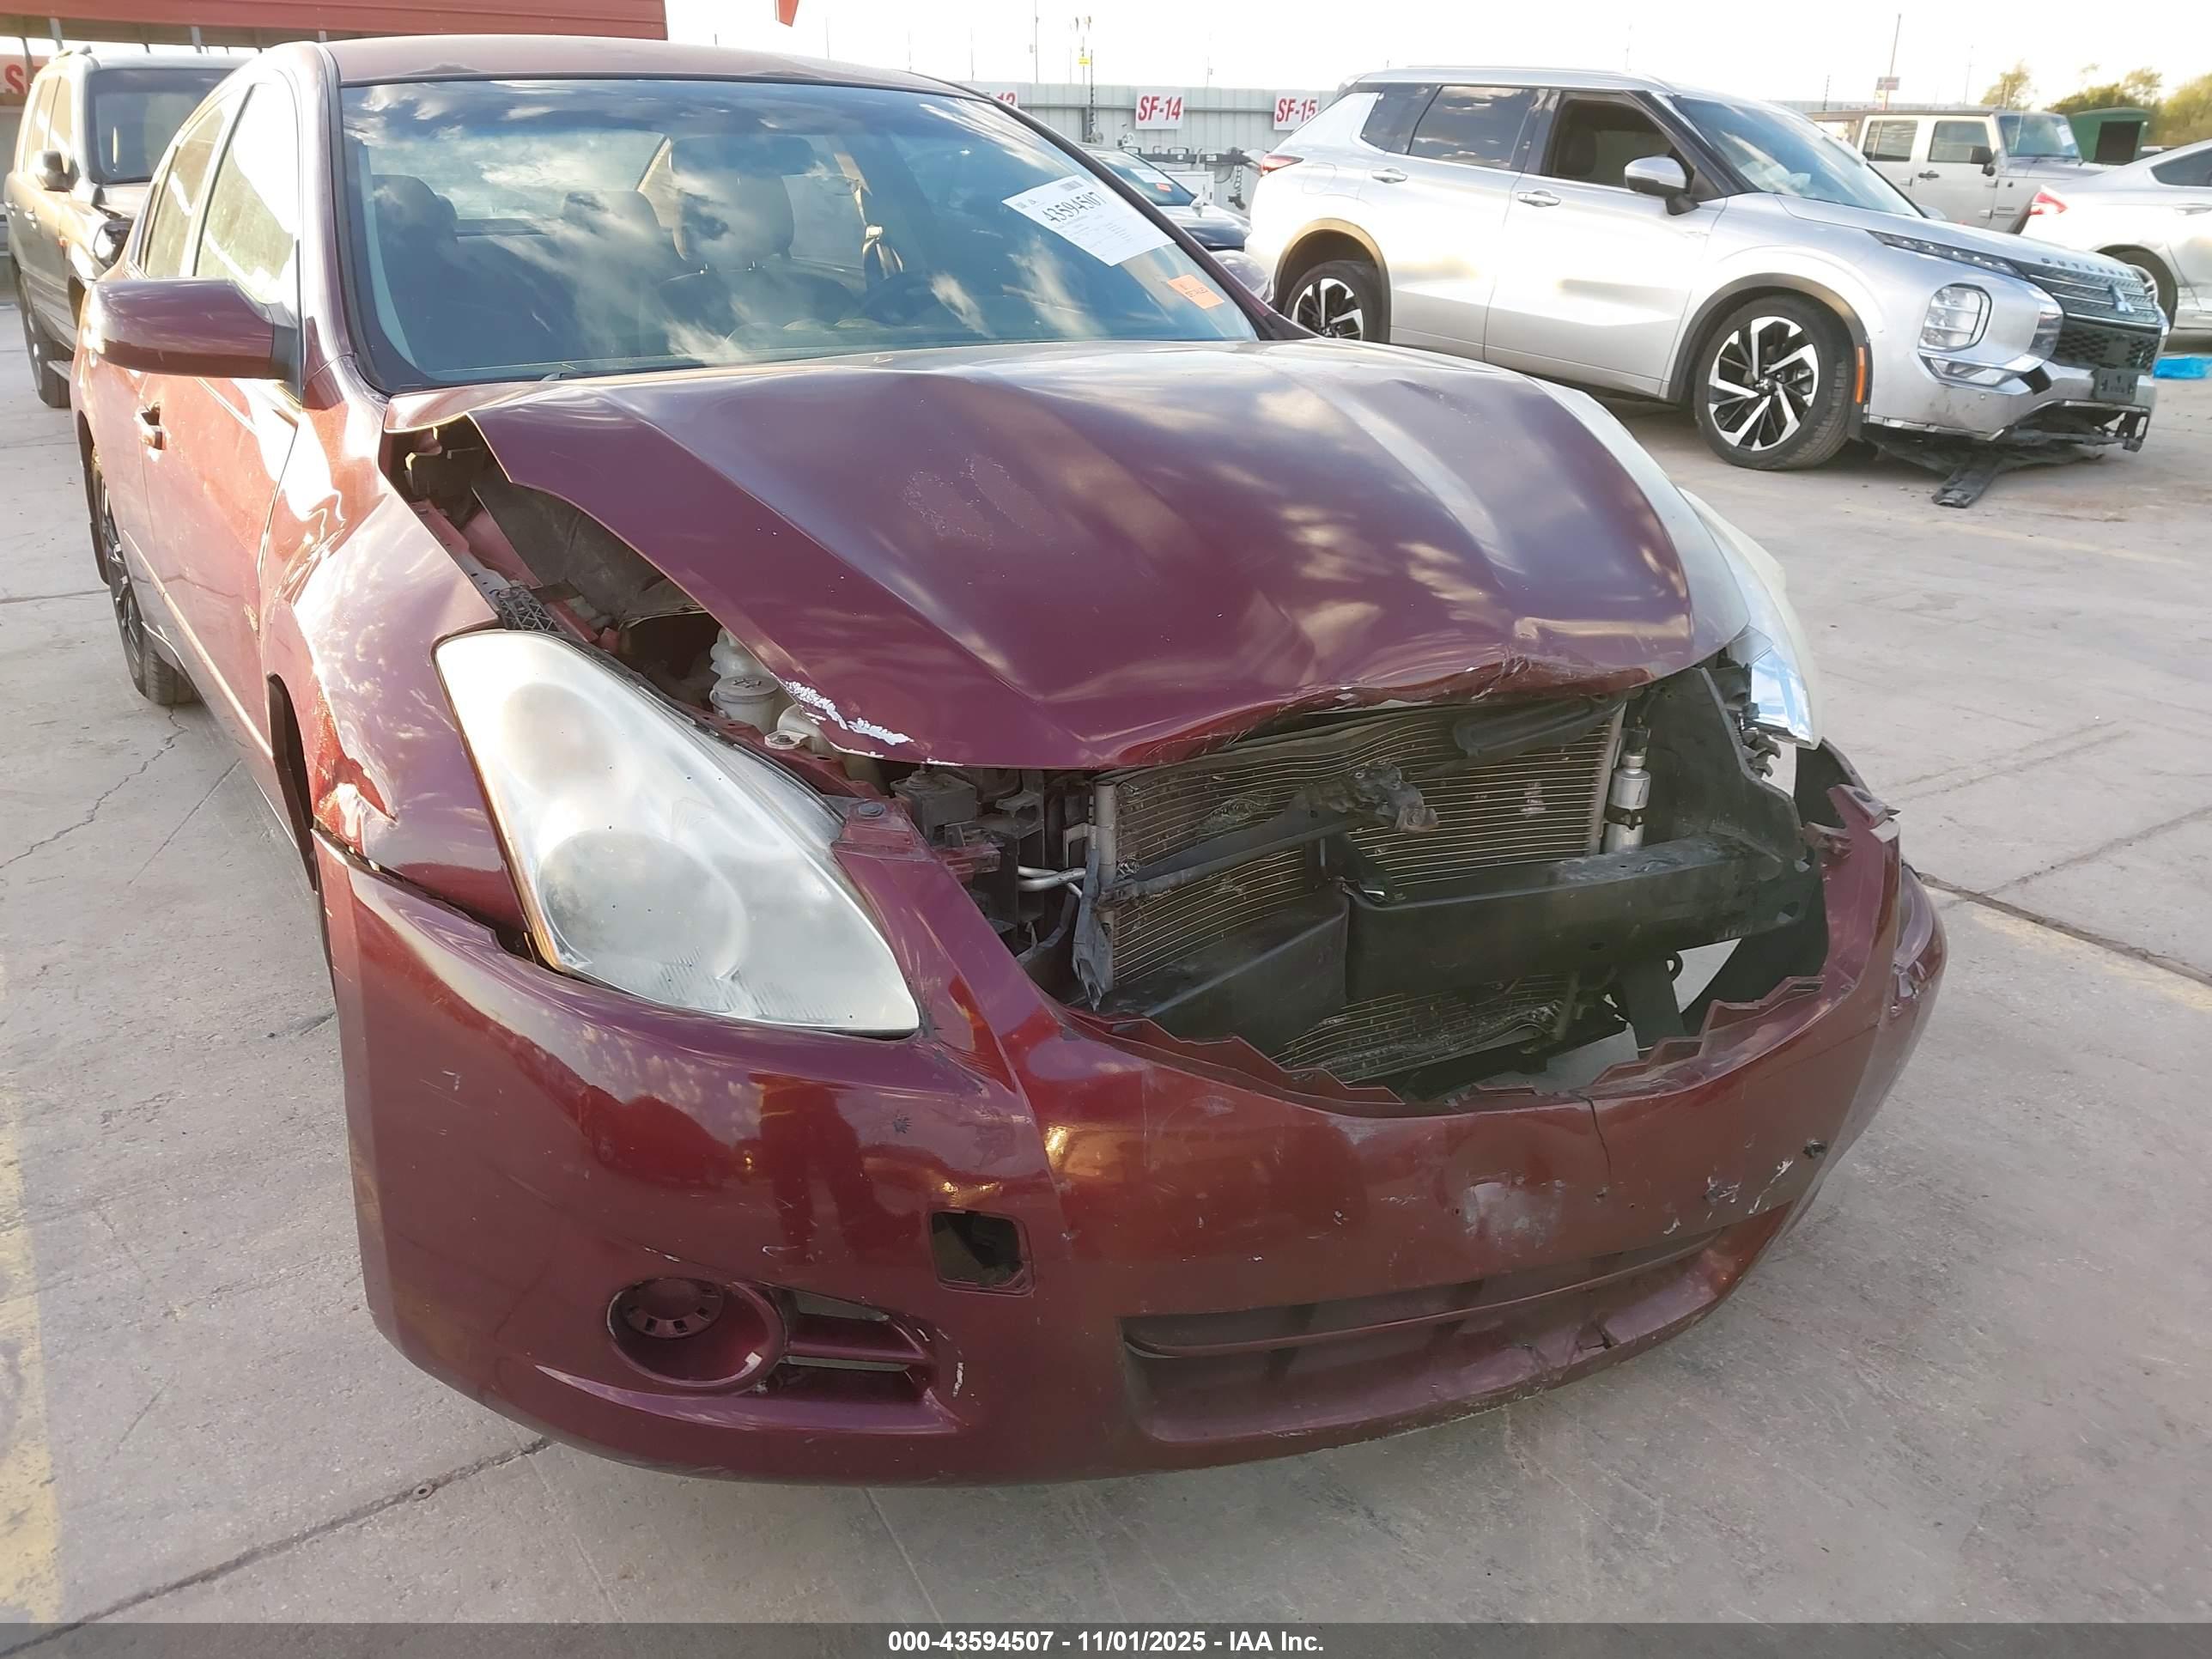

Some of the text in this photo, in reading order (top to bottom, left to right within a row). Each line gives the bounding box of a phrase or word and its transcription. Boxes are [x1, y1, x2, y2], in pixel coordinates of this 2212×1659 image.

[1138, 95, 1182, 120] SF-14
[1276, 98, 1317, 122] SF-15
[1042, 191, 1107, 222] 43594507
